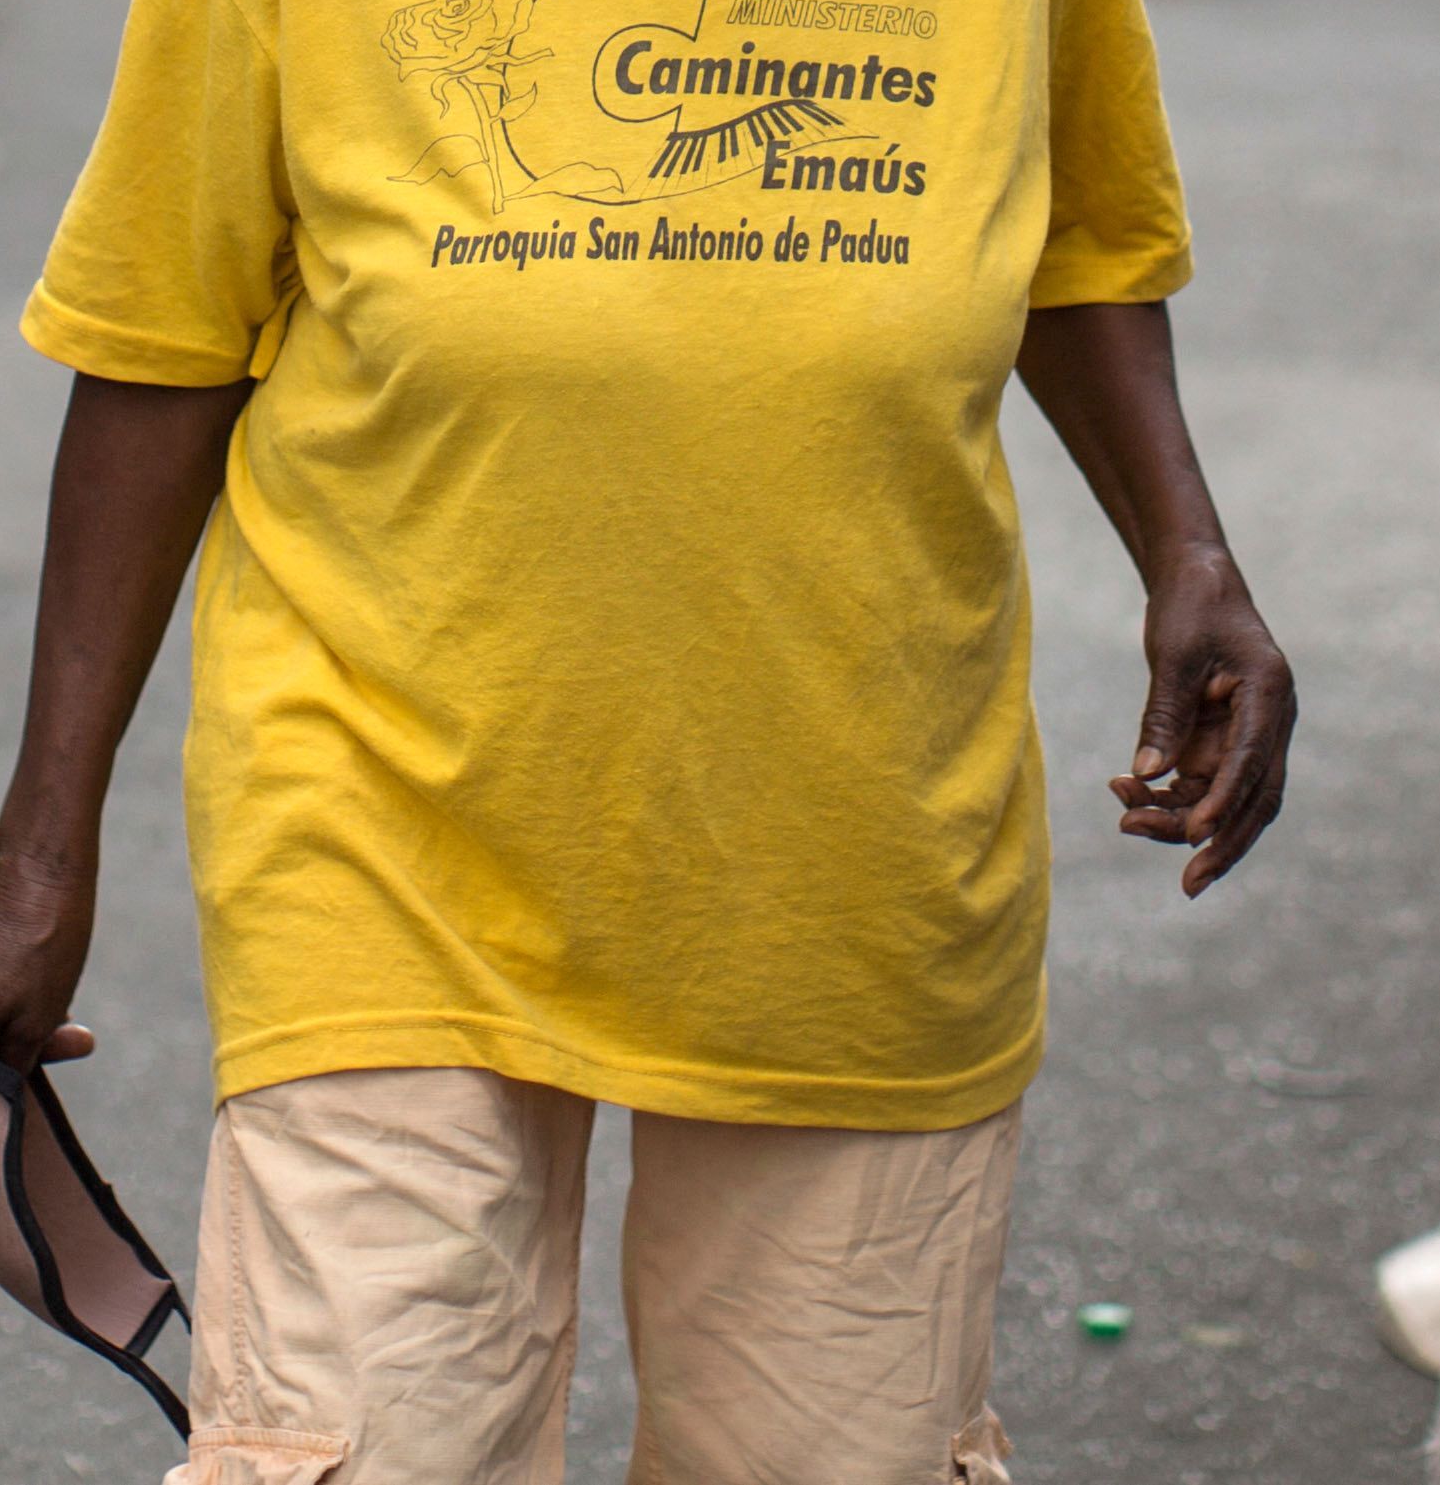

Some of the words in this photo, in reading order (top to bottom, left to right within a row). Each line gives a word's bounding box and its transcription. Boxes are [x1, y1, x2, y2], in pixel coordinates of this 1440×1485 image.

[614, 40, 937, 108] Caminantes
[761, 141, 927, 197] Emaús
[431, 220, 576, 271] Parroquia
[586, 217, 641, 261] San
[647, 217, 764, 261] Antonio
[772, 217, 810, 263] de
[819, 218, 911, 265] Padua
